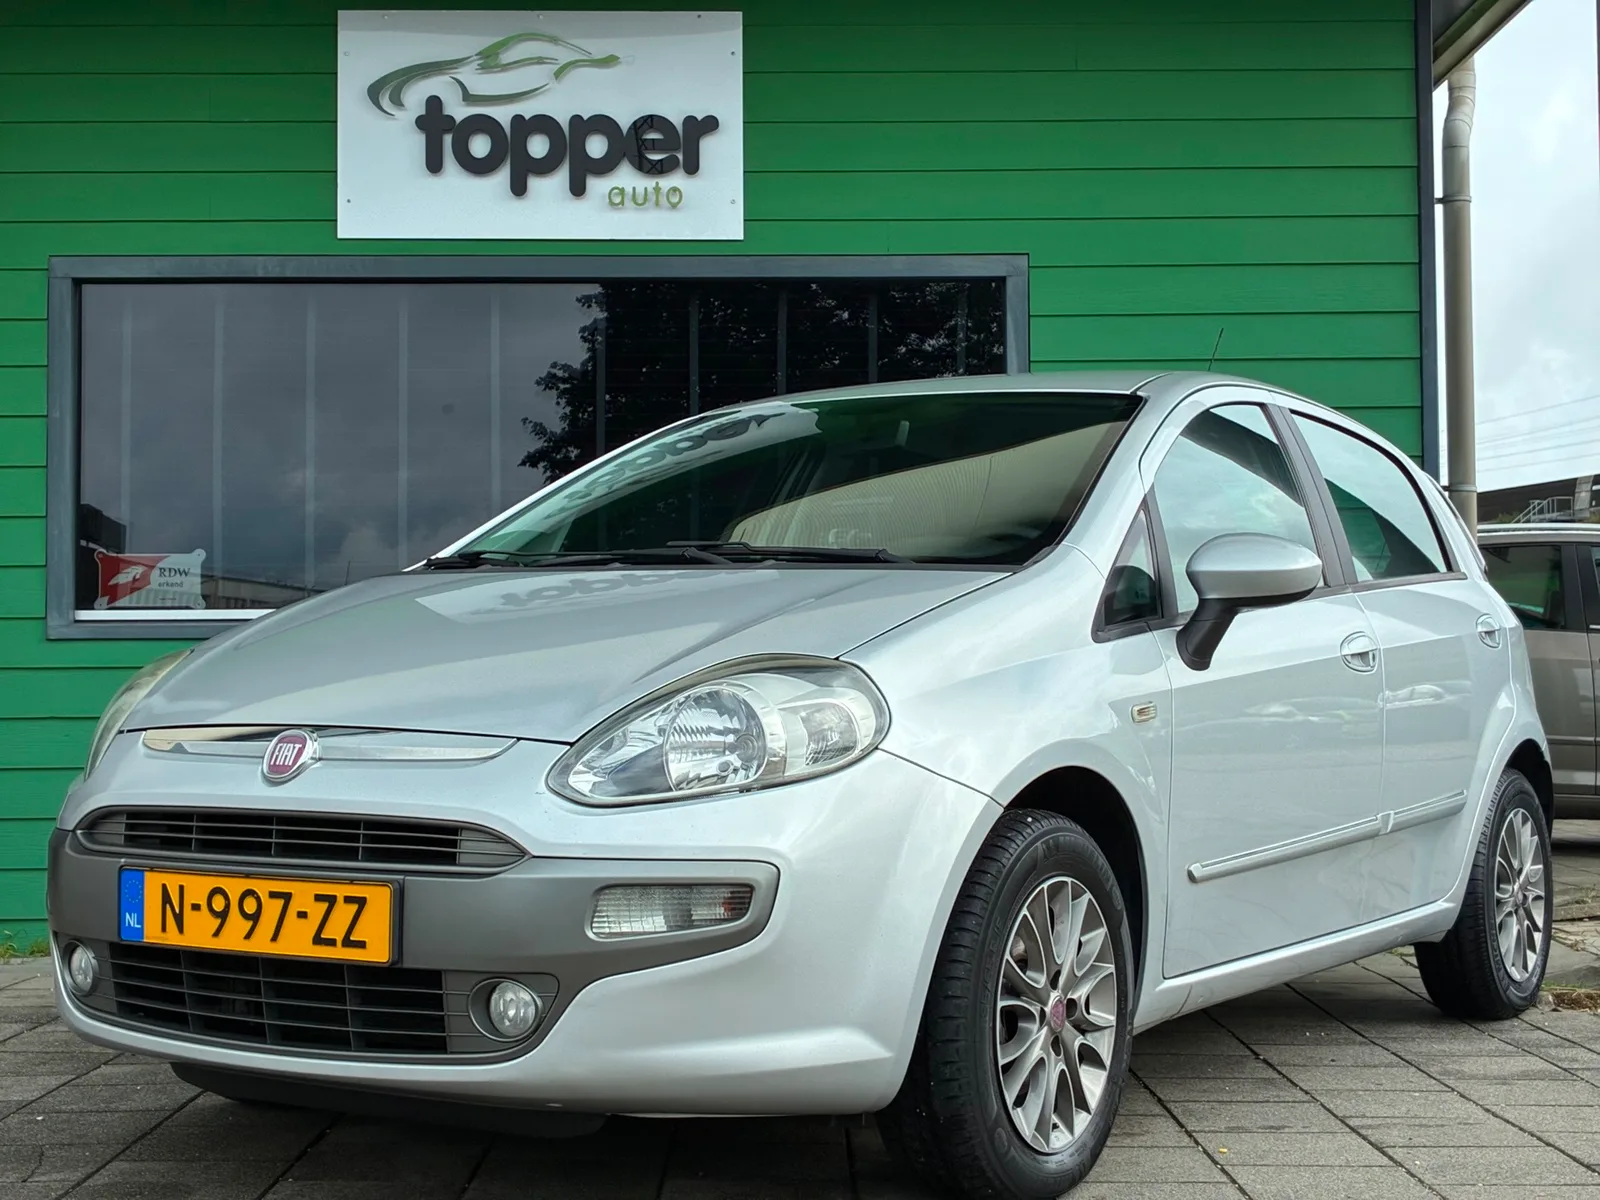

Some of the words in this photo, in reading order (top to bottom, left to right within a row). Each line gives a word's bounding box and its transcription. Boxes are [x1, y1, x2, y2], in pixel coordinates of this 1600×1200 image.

[415, 95, 719, 198] topper
[608, 181, 683, 208] auto
[158, 567, 191, 578] RDW
[158, 580, 184, 588] erkend
[270, 743, 302, 766] FIAT
[125, 912, 141, 928] NL
[161, 882, 368, 949] N-997-ZZ
